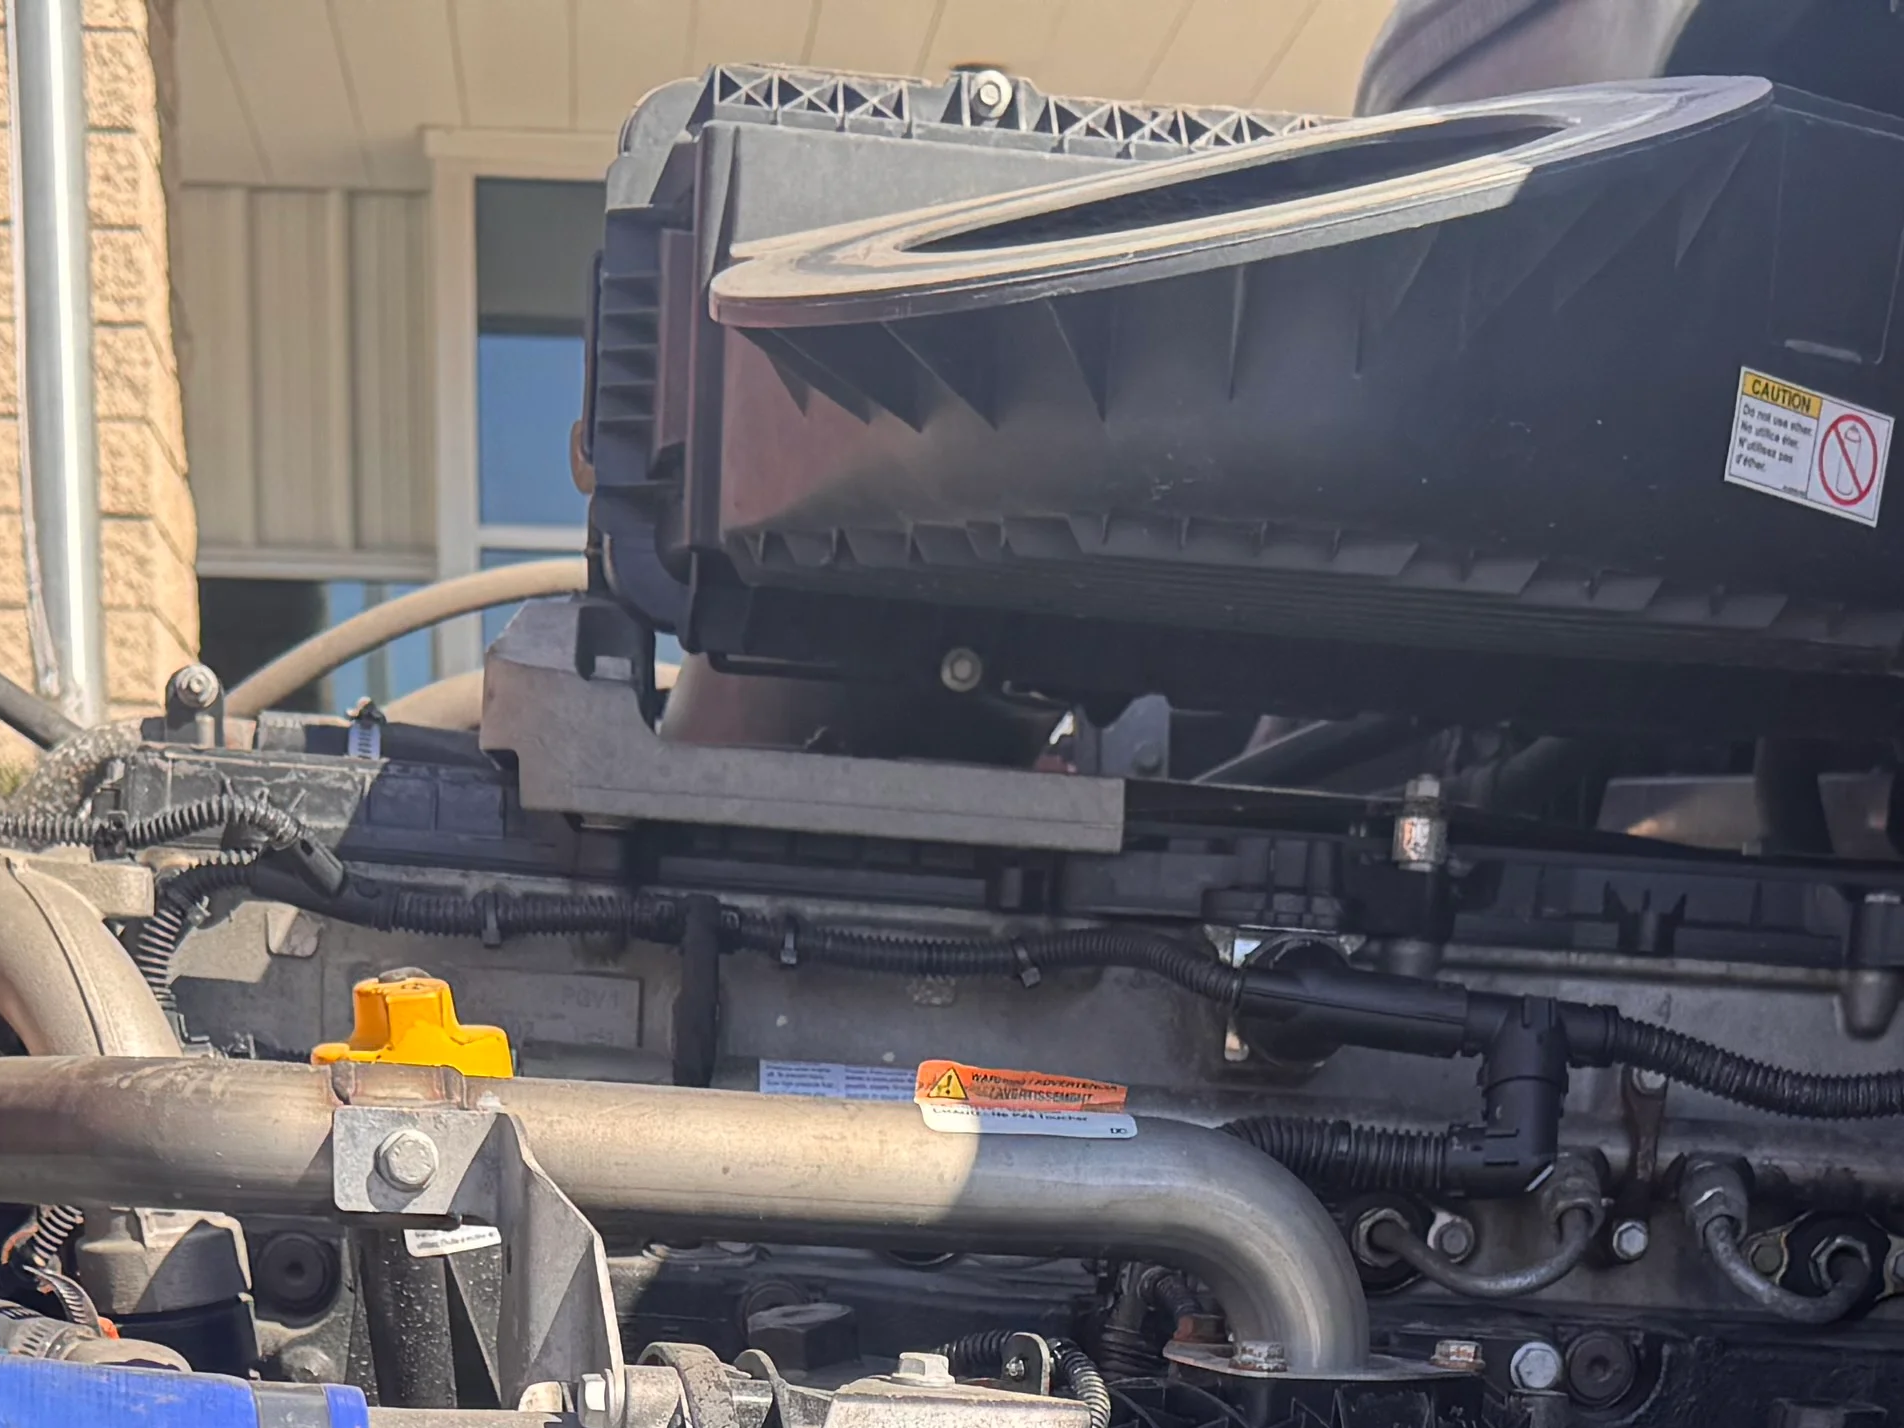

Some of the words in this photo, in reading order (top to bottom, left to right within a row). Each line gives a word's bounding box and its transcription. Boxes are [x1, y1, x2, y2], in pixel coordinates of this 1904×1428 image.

[1752, 379, 1811, 413] CAUTION
[1742, 404, 1755, 416] Do
[1757, 410, 1771, 420] not
[1773, 415, 1788, 428] use
